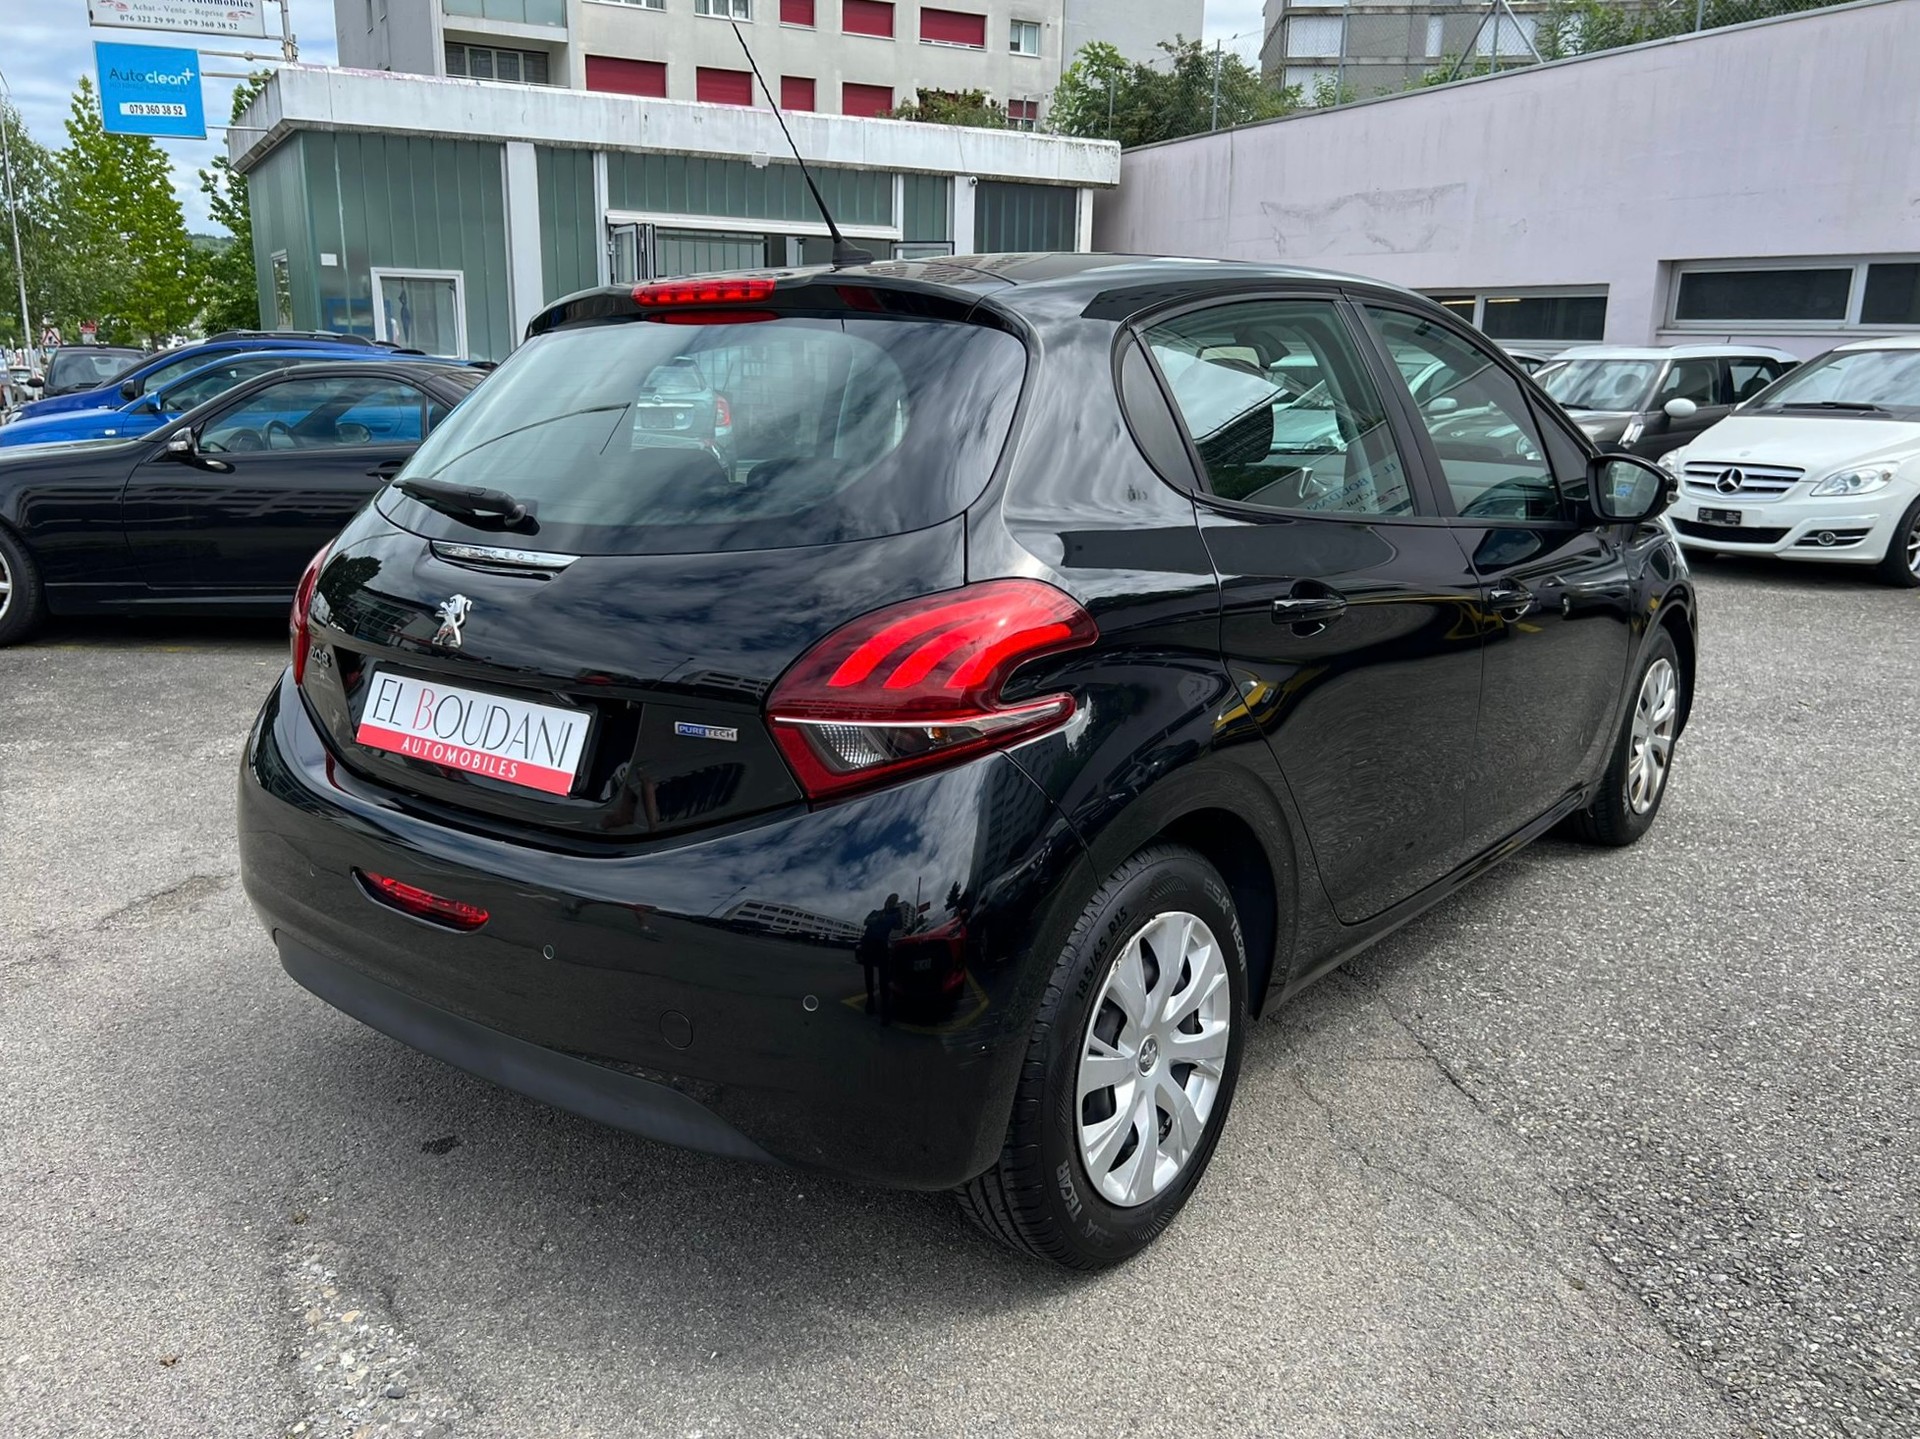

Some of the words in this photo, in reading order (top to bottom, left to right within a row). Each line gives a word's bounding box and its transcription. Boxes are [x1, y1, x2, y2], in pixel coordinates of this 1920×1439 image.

[129, 104, 144, 114] 079
[146, 104, 160, 115] 360
[162, 105, 172, 115] 38
[173, 105, 183, 115] 52
[311, 645, 329, 668] 208
[373, 678, 403, 726] EL
[412, 688, 573, 768] BOUDANI
[401, 736, 518, 778] AUTOMOBILES
[1075, 936, 1108, 999] 185/65
[1108, 905, 1127, 936] R15
